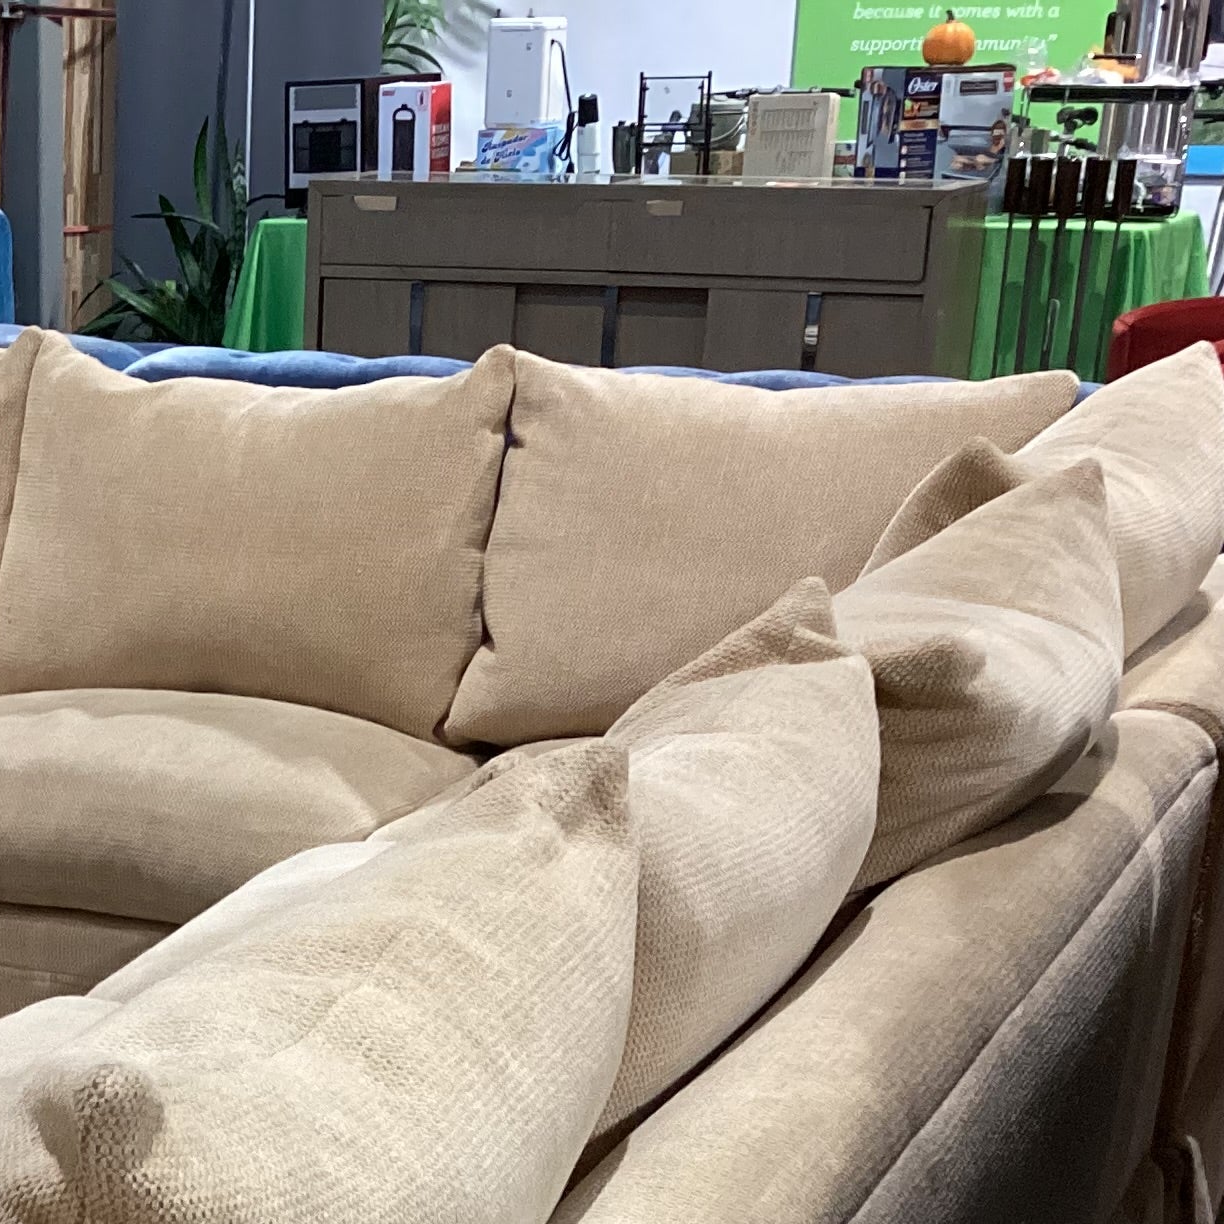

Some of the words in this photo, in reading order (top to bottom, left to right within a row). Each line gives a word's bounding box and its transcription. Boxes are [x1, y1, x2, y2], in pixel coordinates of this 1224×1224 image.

[852, 2, 925, 20] because
[929, 4, 942, 20] it
[951, 7, 1001, 19] omes
[1006, 0, 1044, 19] with
[1048, 6, 1061, 19] a
[850, 36, 923, 55] supporti
[907, 77, 939, 95] Oster
